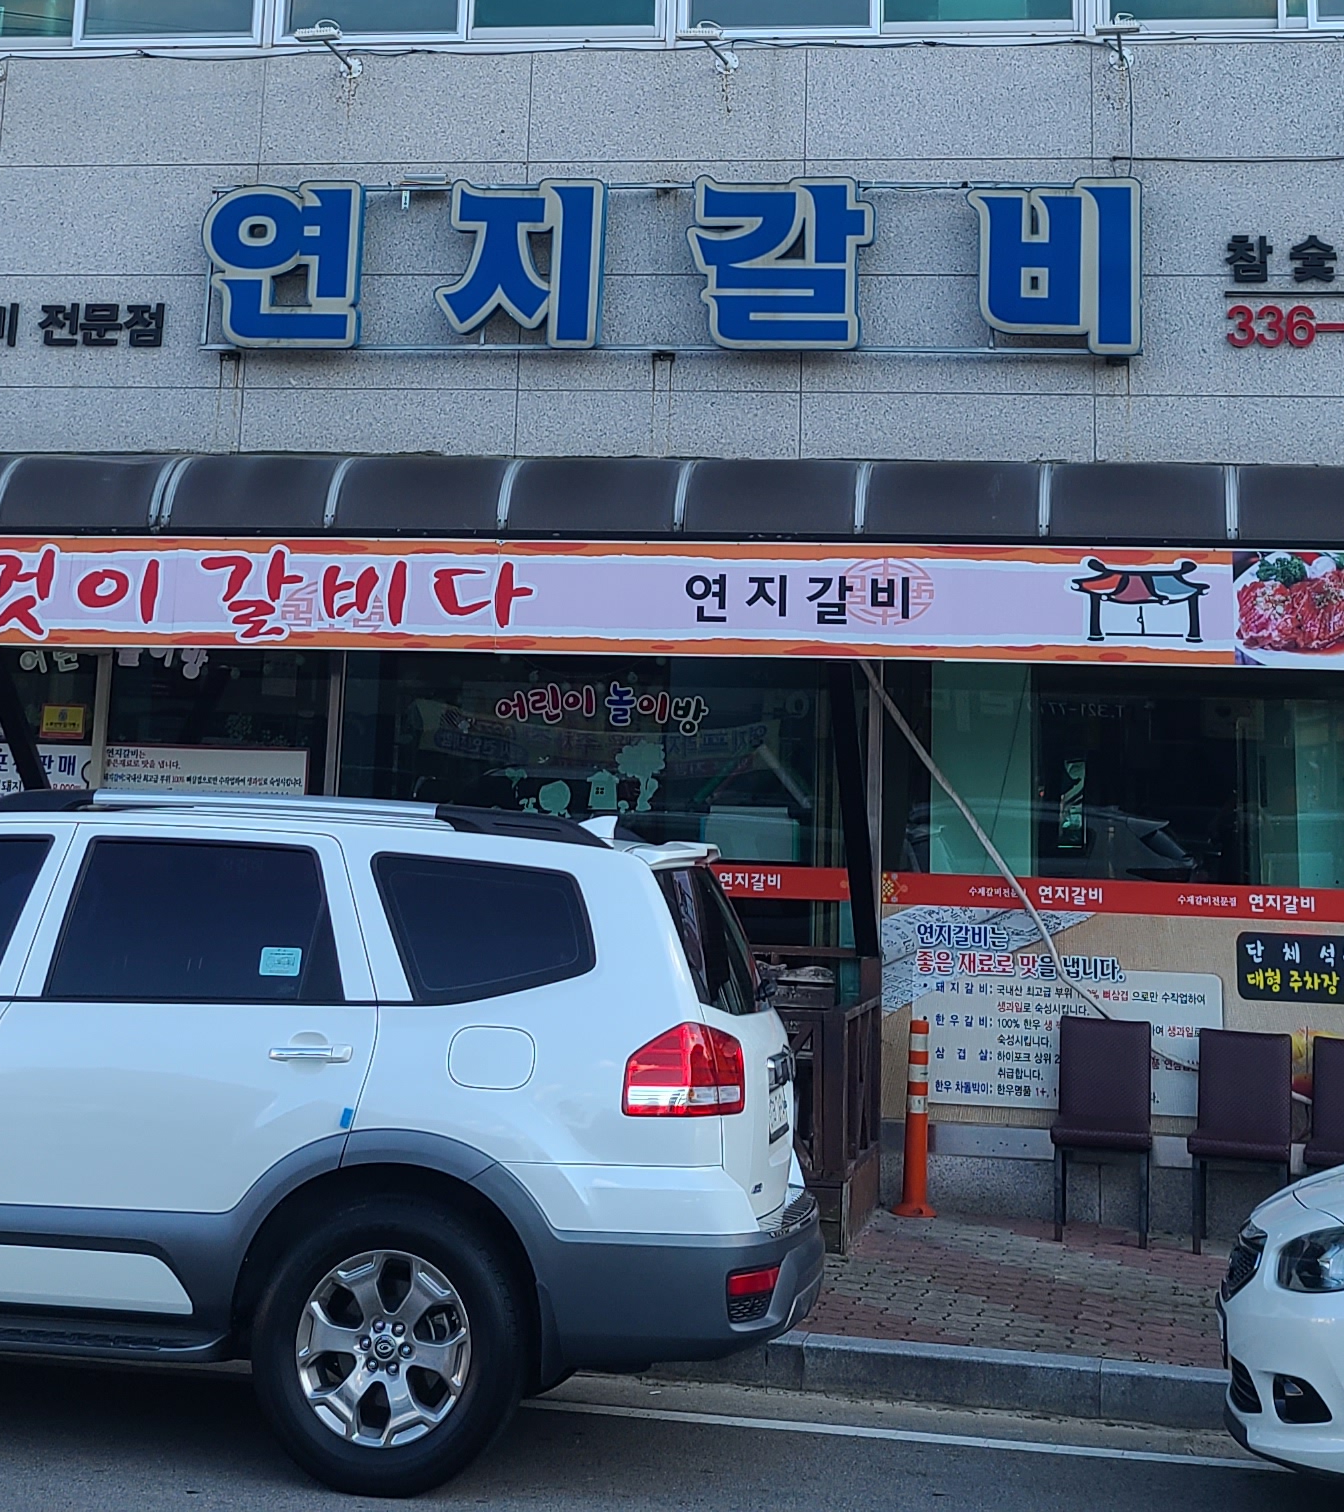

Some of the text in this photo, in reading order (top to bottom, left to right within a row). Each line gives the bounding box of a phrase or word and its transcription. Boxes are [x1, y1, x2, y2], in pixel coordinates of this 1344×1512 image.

[38, 302, 166, 348] 전문점
[201, 176, 1142, 355] 연지갈비
[198, 545, 535, 643] 갈비다
[683, 571, 913, 628] 연지갈비
[495, 680, 710, 736] 어린이 놀이방
[719, 872, 782, 891] 연지갈비
[1038, 885, 1104, 905] 연지갈비
[1177, 893, 1316, 915] 수제갈비전문점 연지갈비
[916, 923, 1008, 949] 연지갈비는
[916, 950, 1126, 982] 좋은 재료로 맛을 냅니다.
[1246, 968, 1281, 993] 대형
[1289, 971, 1340, 995] 주차장
[997, 984, 1023, 997] 국내산
[1026, 985, 1052, 999] 최고급
[1055, 987, 1073, 999] 부위
[1161, 992, 1206, 1005] 수작업하여
[997, 1001, 1032, 1014] 생과일로
[997, 1018, 1020, 1030] 100%
[1024, 1018, 1041, 1031] 한우
[997, 1051, 1031, 1064] 하이포크
[1034, 1052, 1052, 1065] 상위
[935, 1080, 952, 1093] 한우
[997, 1084, 1032, 1097] 한우명품
